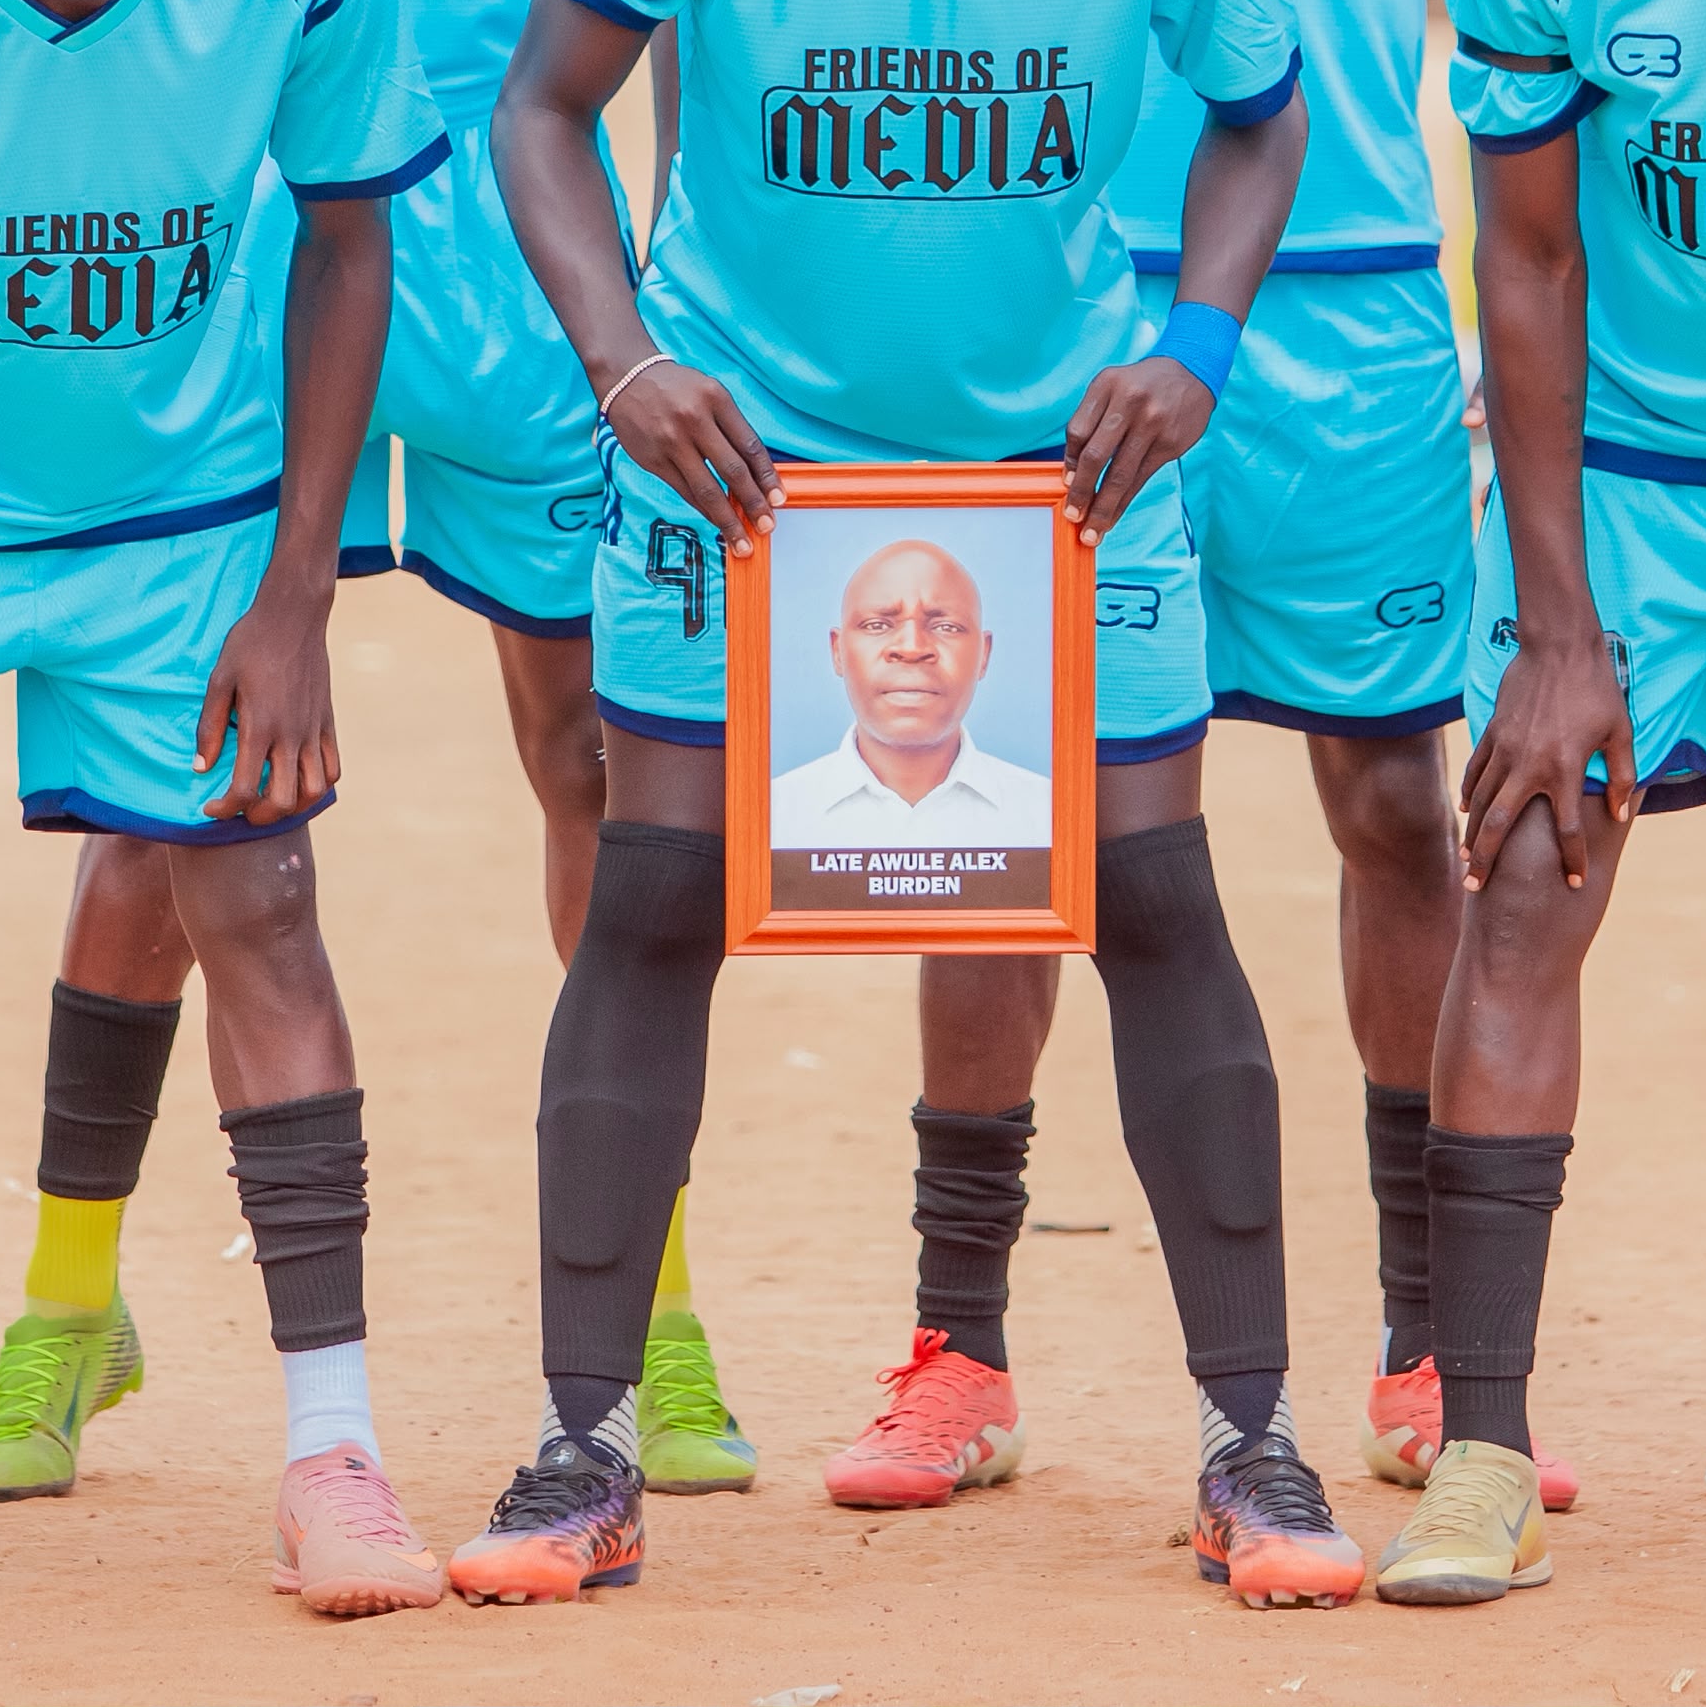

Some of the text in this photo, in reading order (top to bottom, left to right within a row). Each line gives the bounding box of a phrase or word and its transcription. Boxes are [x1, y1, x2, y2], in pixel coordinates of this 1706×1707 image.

[804, 46, 1069, 92] FRIENDS OF
[770, 93, 1081, 193] MEDIA
[162, 202, 215, 246] OF
[810, 852, 1007, 872] LATE AWULE ALEX
[868, 876, 961, 895] BURDEN
